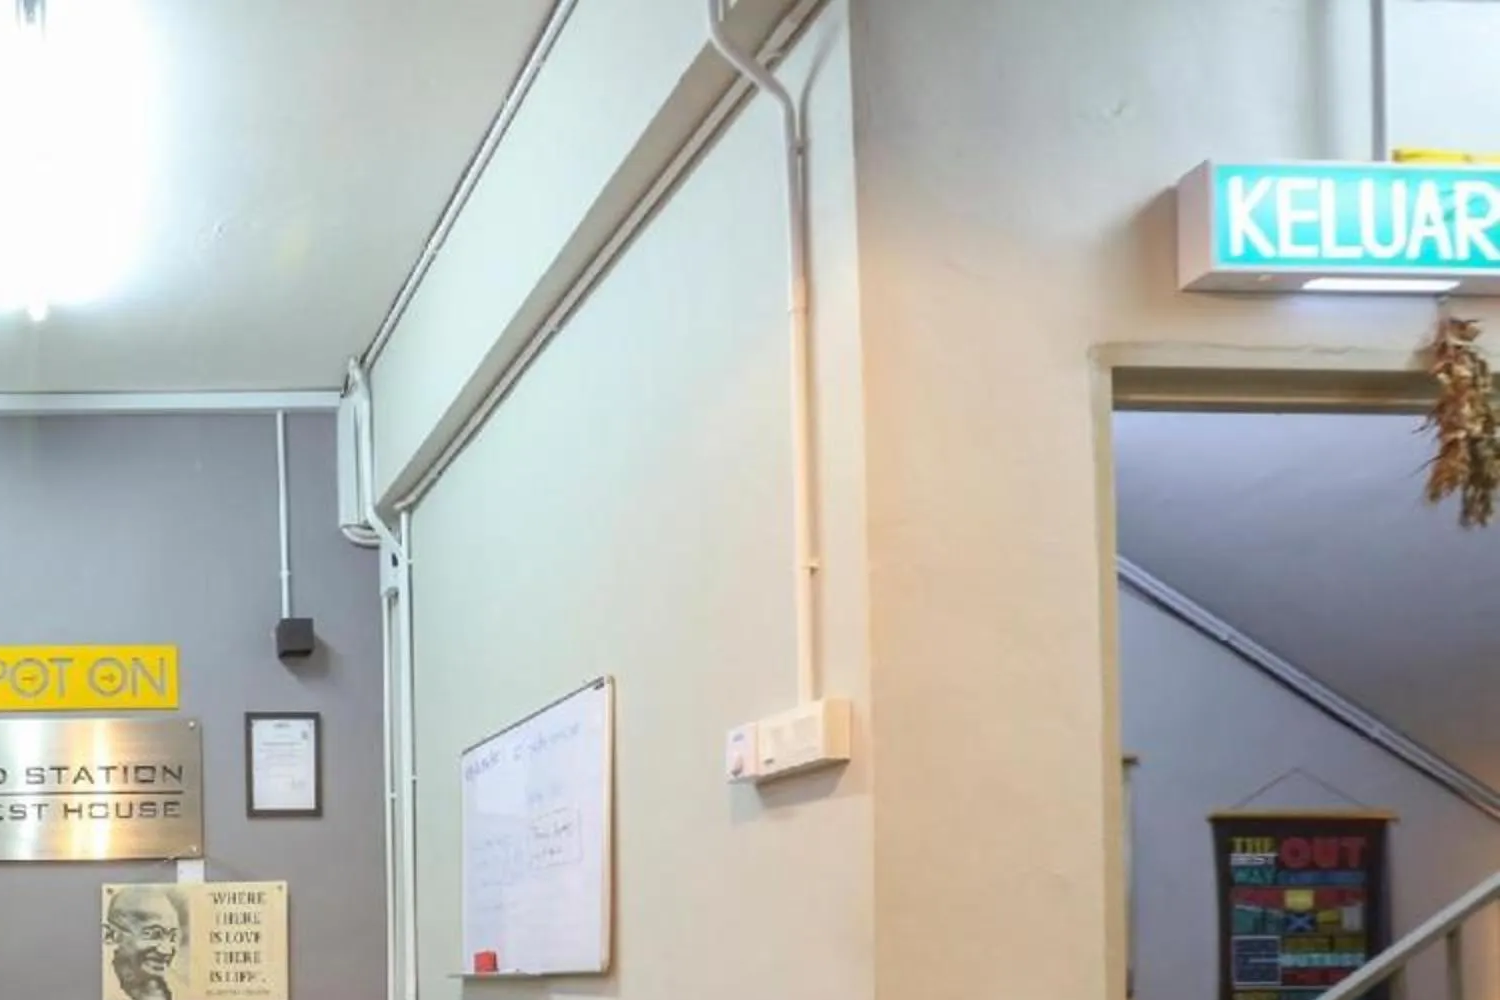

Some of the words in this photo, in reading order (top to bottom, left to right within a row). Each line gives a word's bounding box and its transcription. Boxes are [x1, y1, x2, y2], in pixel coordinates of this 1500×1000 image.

[1228, 175, 1500, 260] KELUAR
[89, 657, 165, 697] ON
[25, 764, 183, 786] STATION
[62, 801, 182, 820] HOUSE
